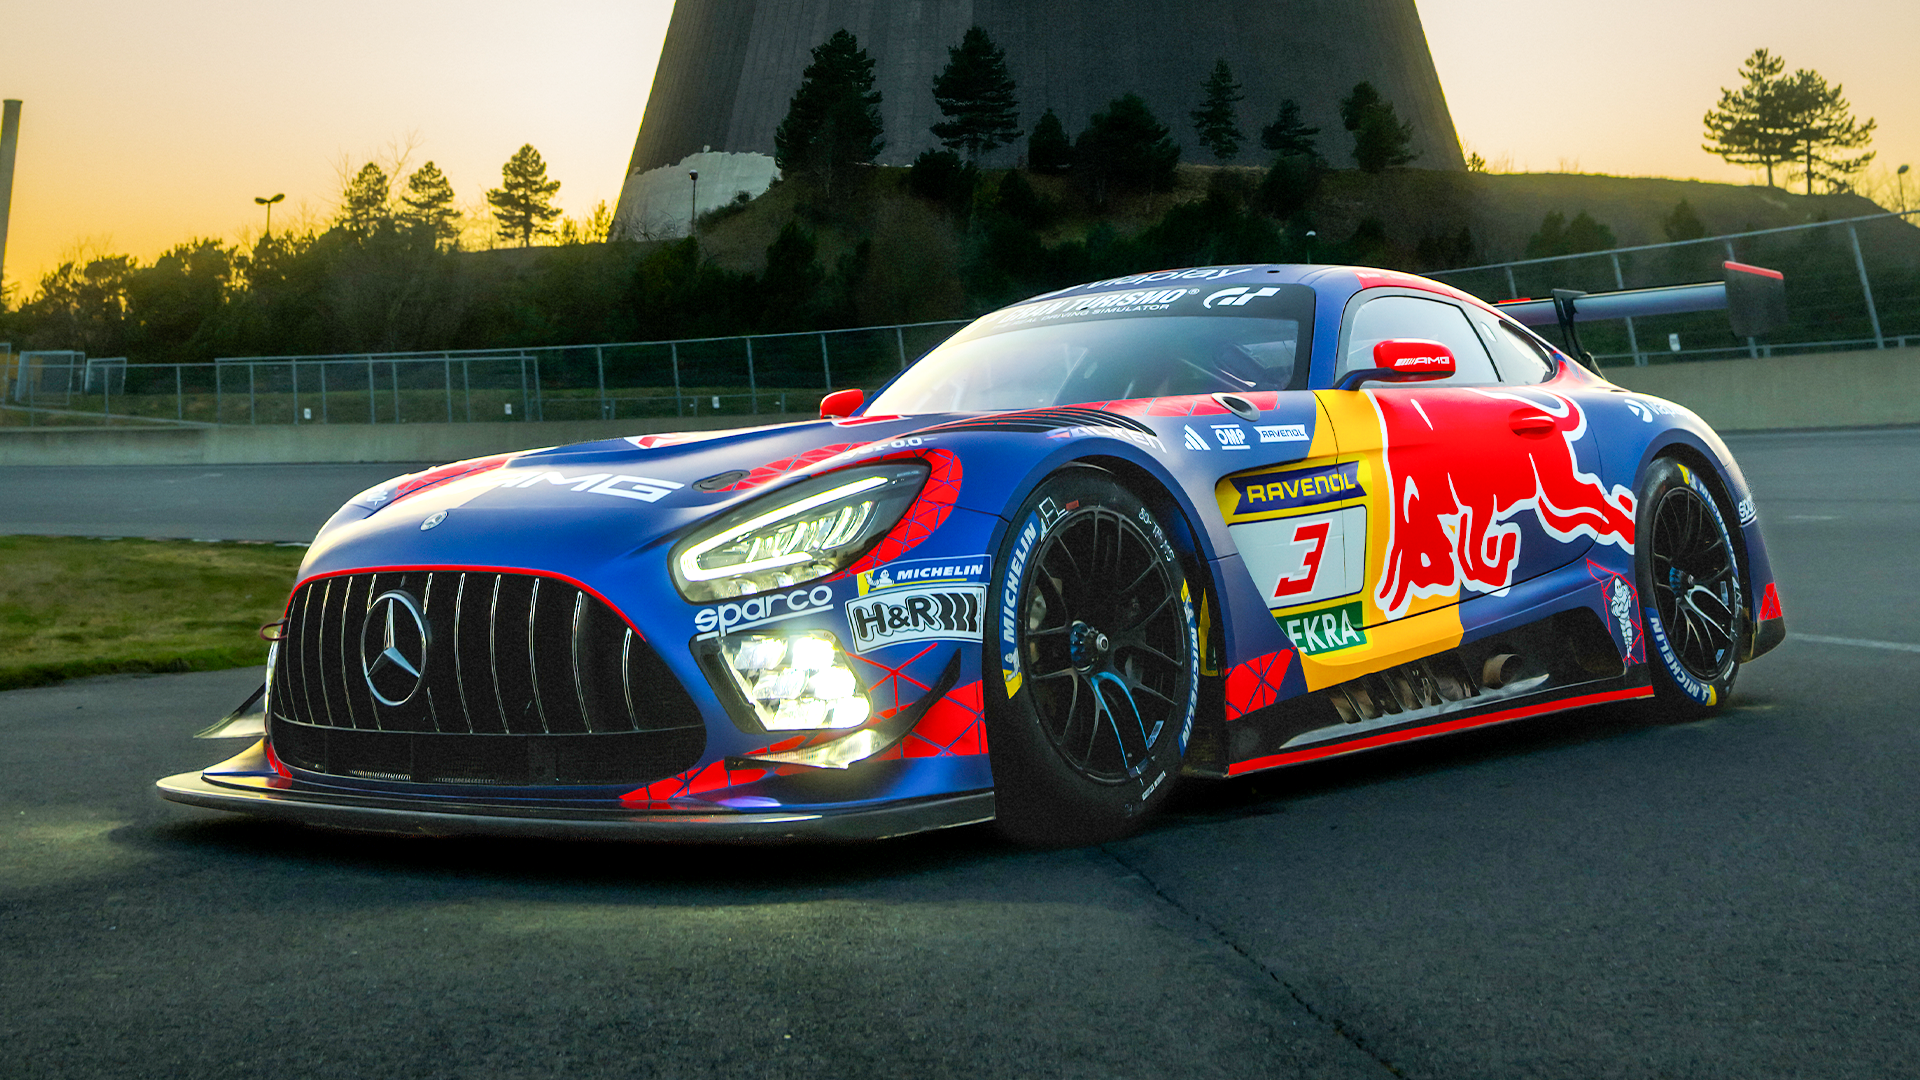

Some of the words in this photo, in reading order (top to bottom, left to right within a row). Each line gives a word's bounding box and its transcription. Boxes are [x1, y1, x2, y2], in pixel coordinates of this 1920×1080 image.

[1092, 304, 1170, 316] SIMULATOR
[1215, 428, 1246, 446] OMP
[1261, 427, 1305, 440] RAVENOL
[484, 470, 685, 504] AMG
[1246, 473, 1356, 503] RAVENOL
[896, 564, 984, 581] MICHELIN
[1270, 518, 1333, 600] 3
[1003, 522, 1037, 644] MICHELIN
[694, 585, 833, 637] sparco
[853, 594, 941, 640] H&R
[1650, 617, 1700, 697] MICHELIN
